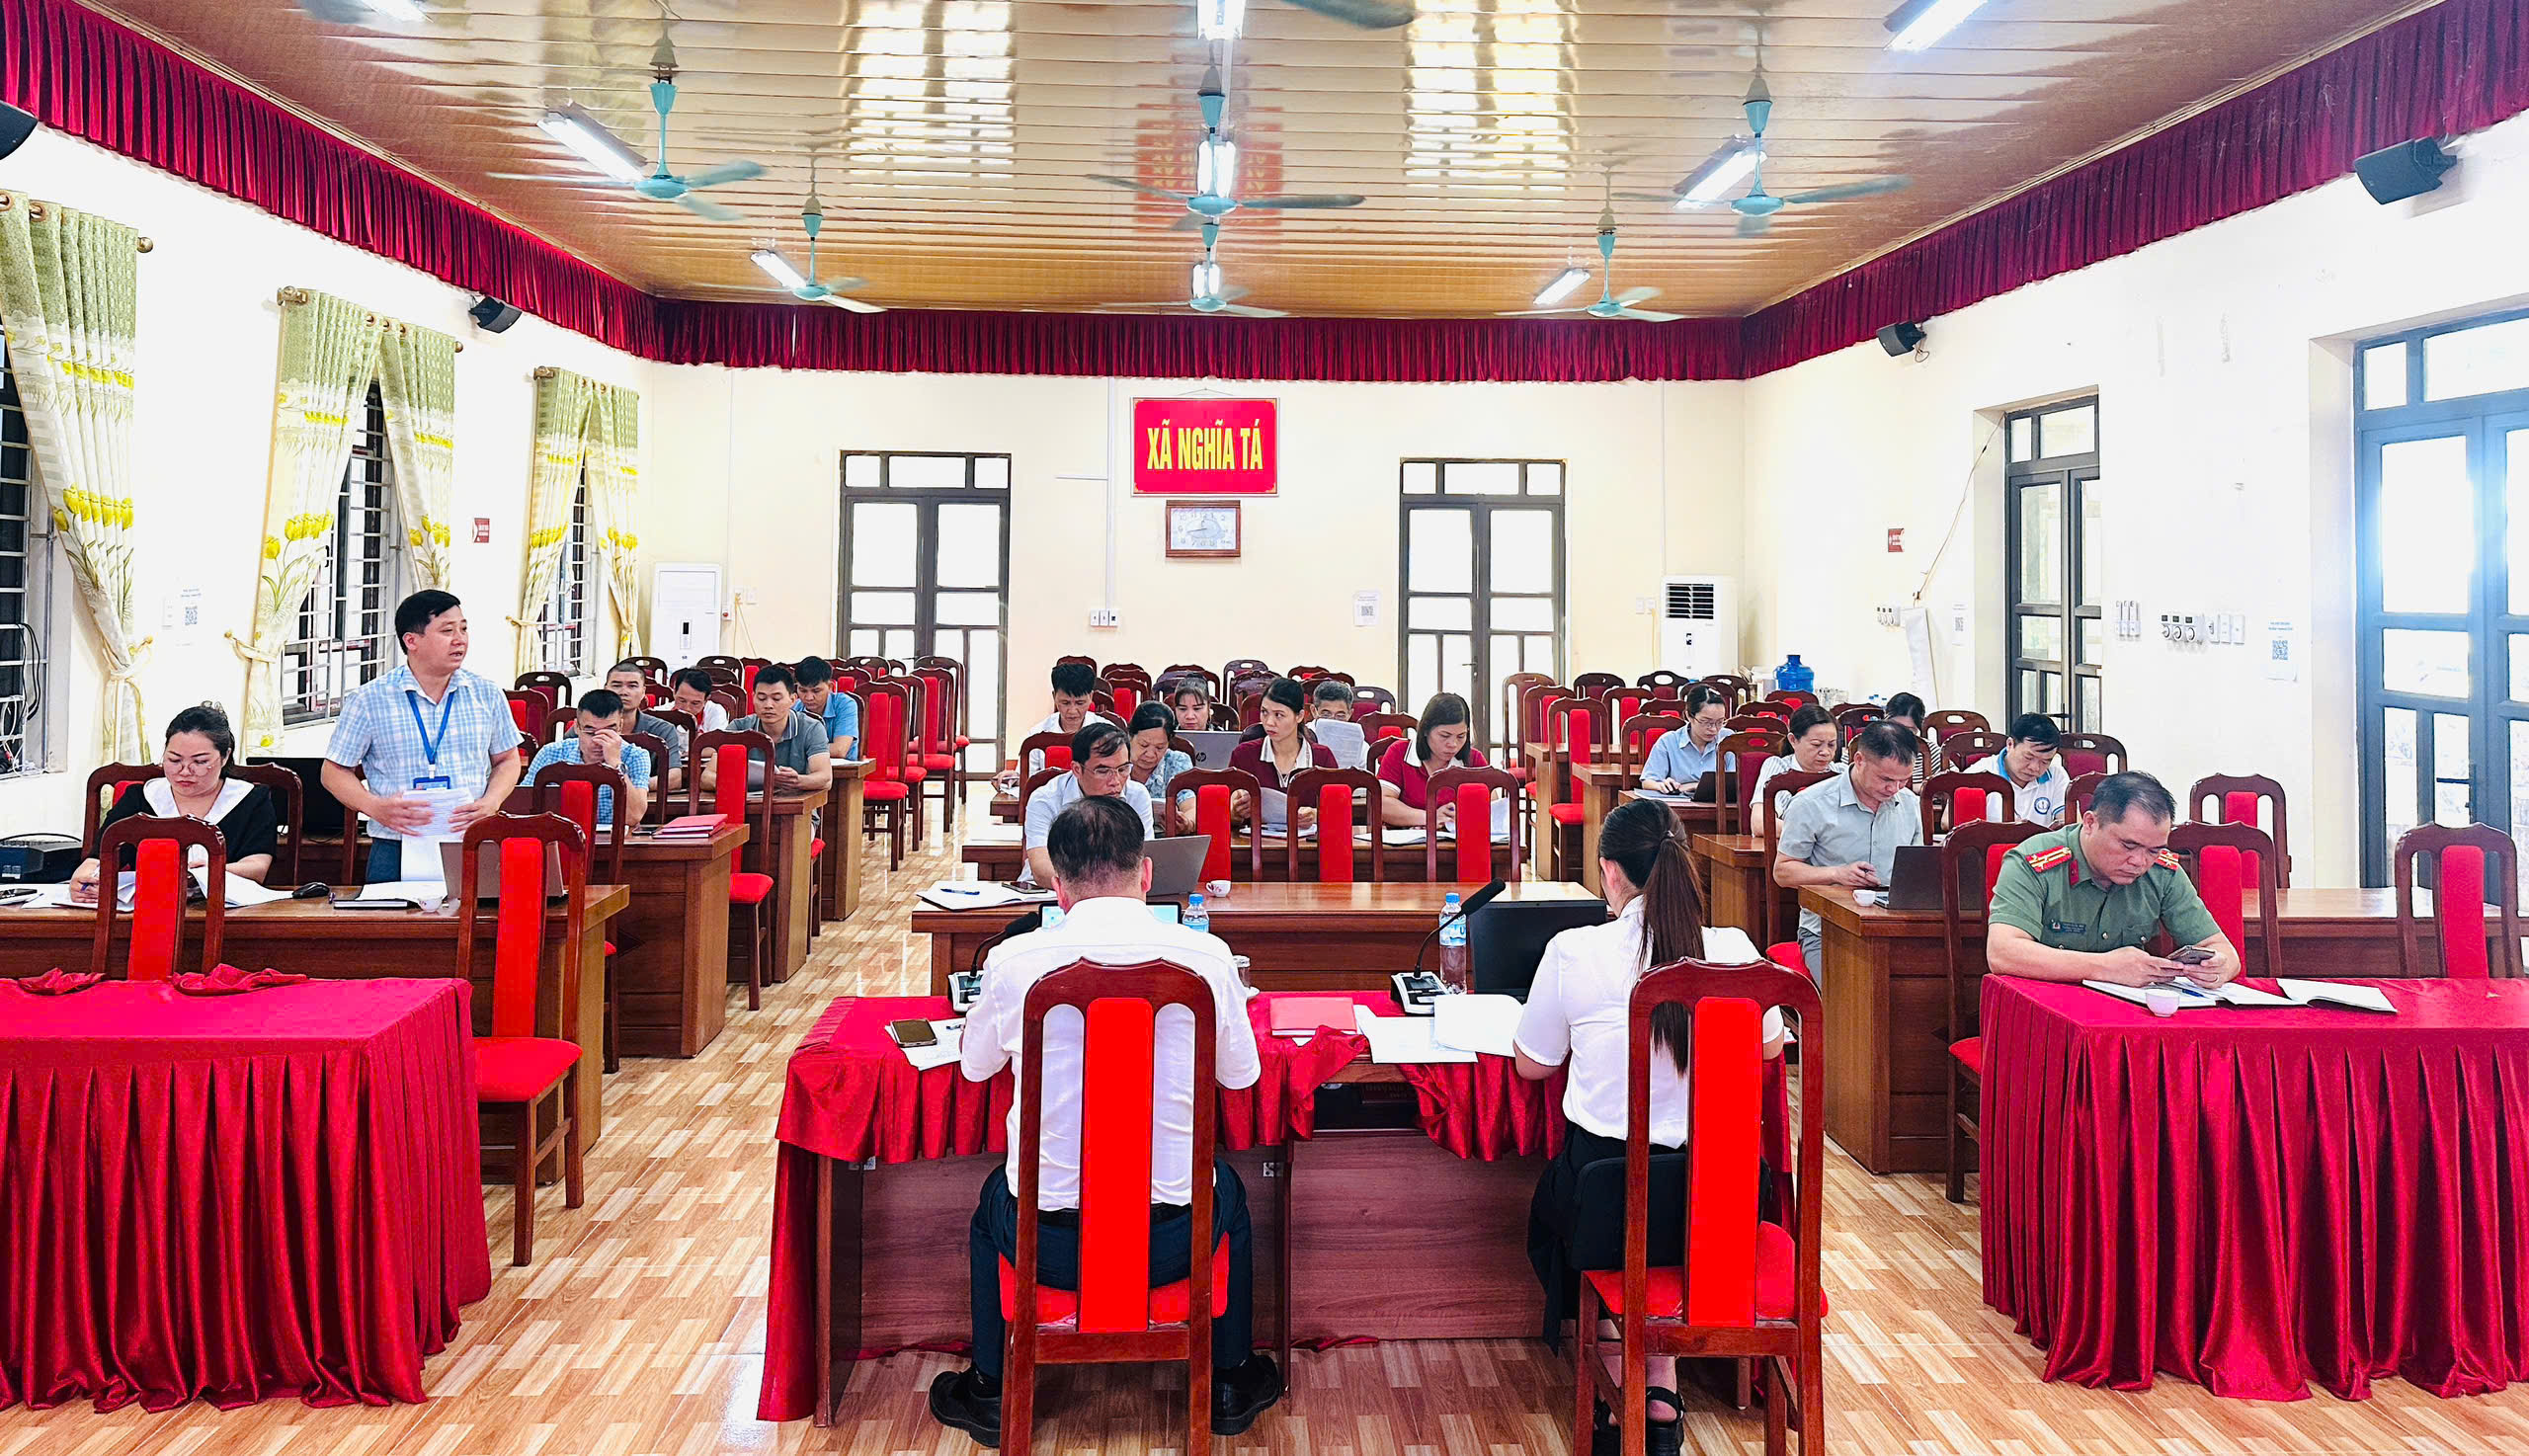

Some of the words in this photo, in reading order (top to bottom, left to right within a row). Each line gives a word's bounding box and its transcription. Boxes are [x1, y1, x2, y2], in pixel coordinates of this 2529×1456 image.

[1147, 419, 1173, 470] XÃ
[1178, 419, 1236, 470] NGHĨA
[1240, 419, 1264, 470] TÁ
